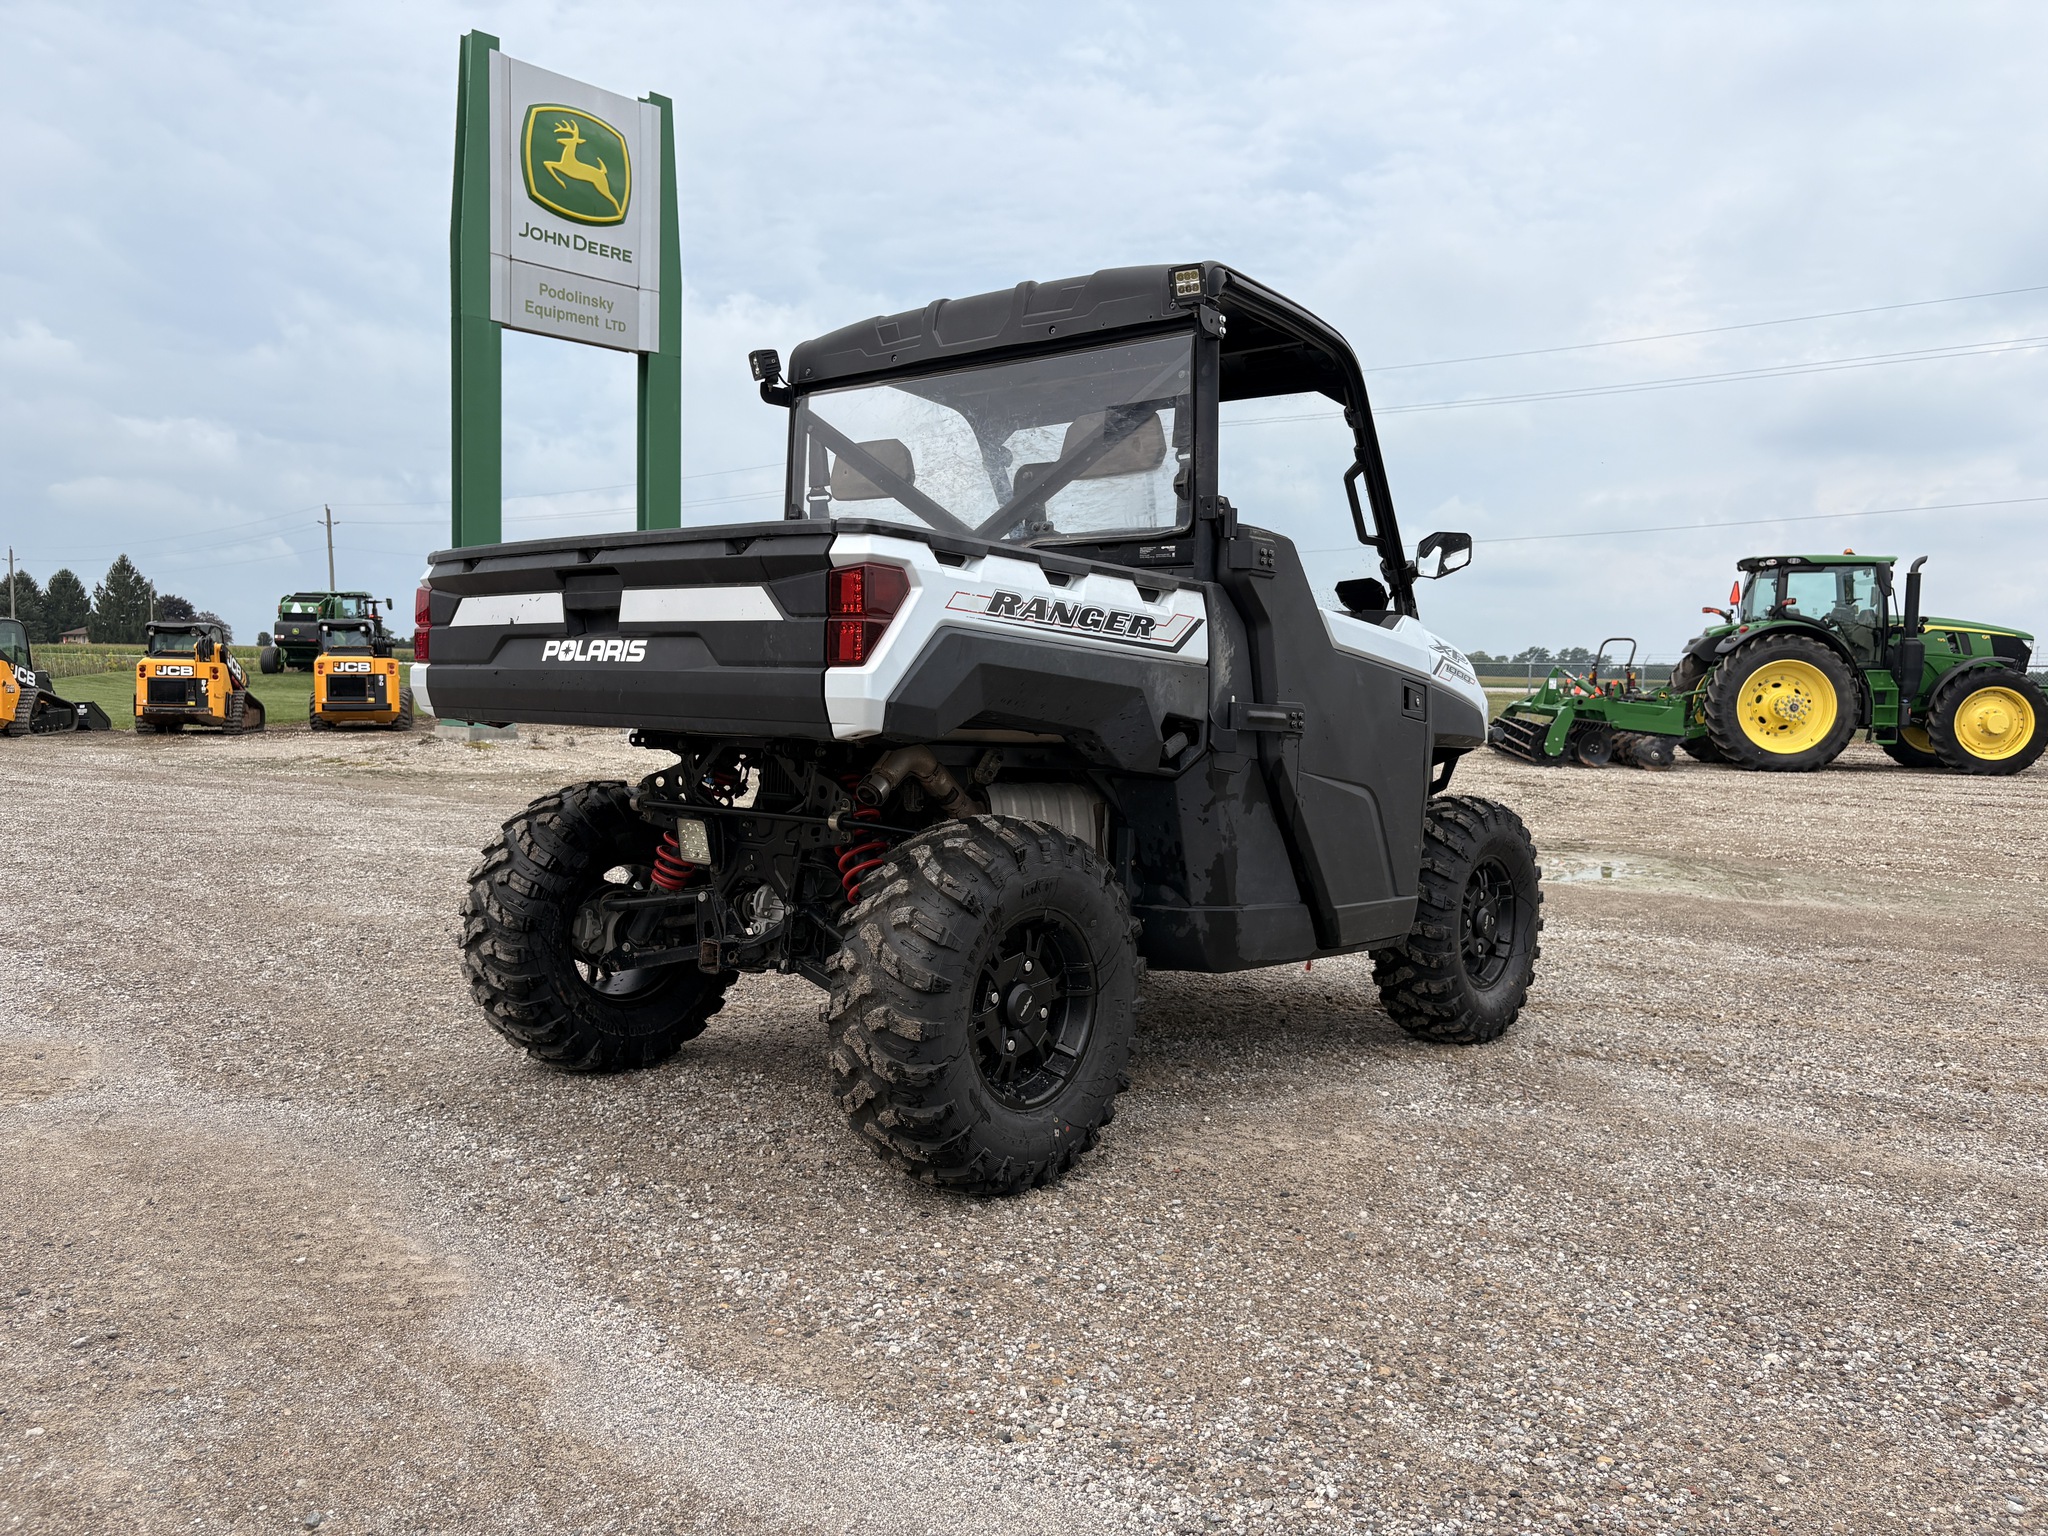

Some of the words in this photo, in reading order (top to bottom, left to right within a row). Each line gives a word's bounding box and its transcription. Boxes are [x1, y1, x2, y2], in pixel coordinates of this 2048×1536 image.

[518, 222, 570, 247] JOHN
[573, 234, 633, 263] DEERE
[539, 283, 614, 313] Podolinsky
[525, 300, 599, 328] Equipment
[605, 319, 626, 332] LTD
[985, 589, 1157, 639] RANGER
[541, 639, 648, 662] POLARIS
[12, 663, 36, 687] JCB
[156, 665, 194, 676] JCB
[333, 662, 371, 672] JCB
